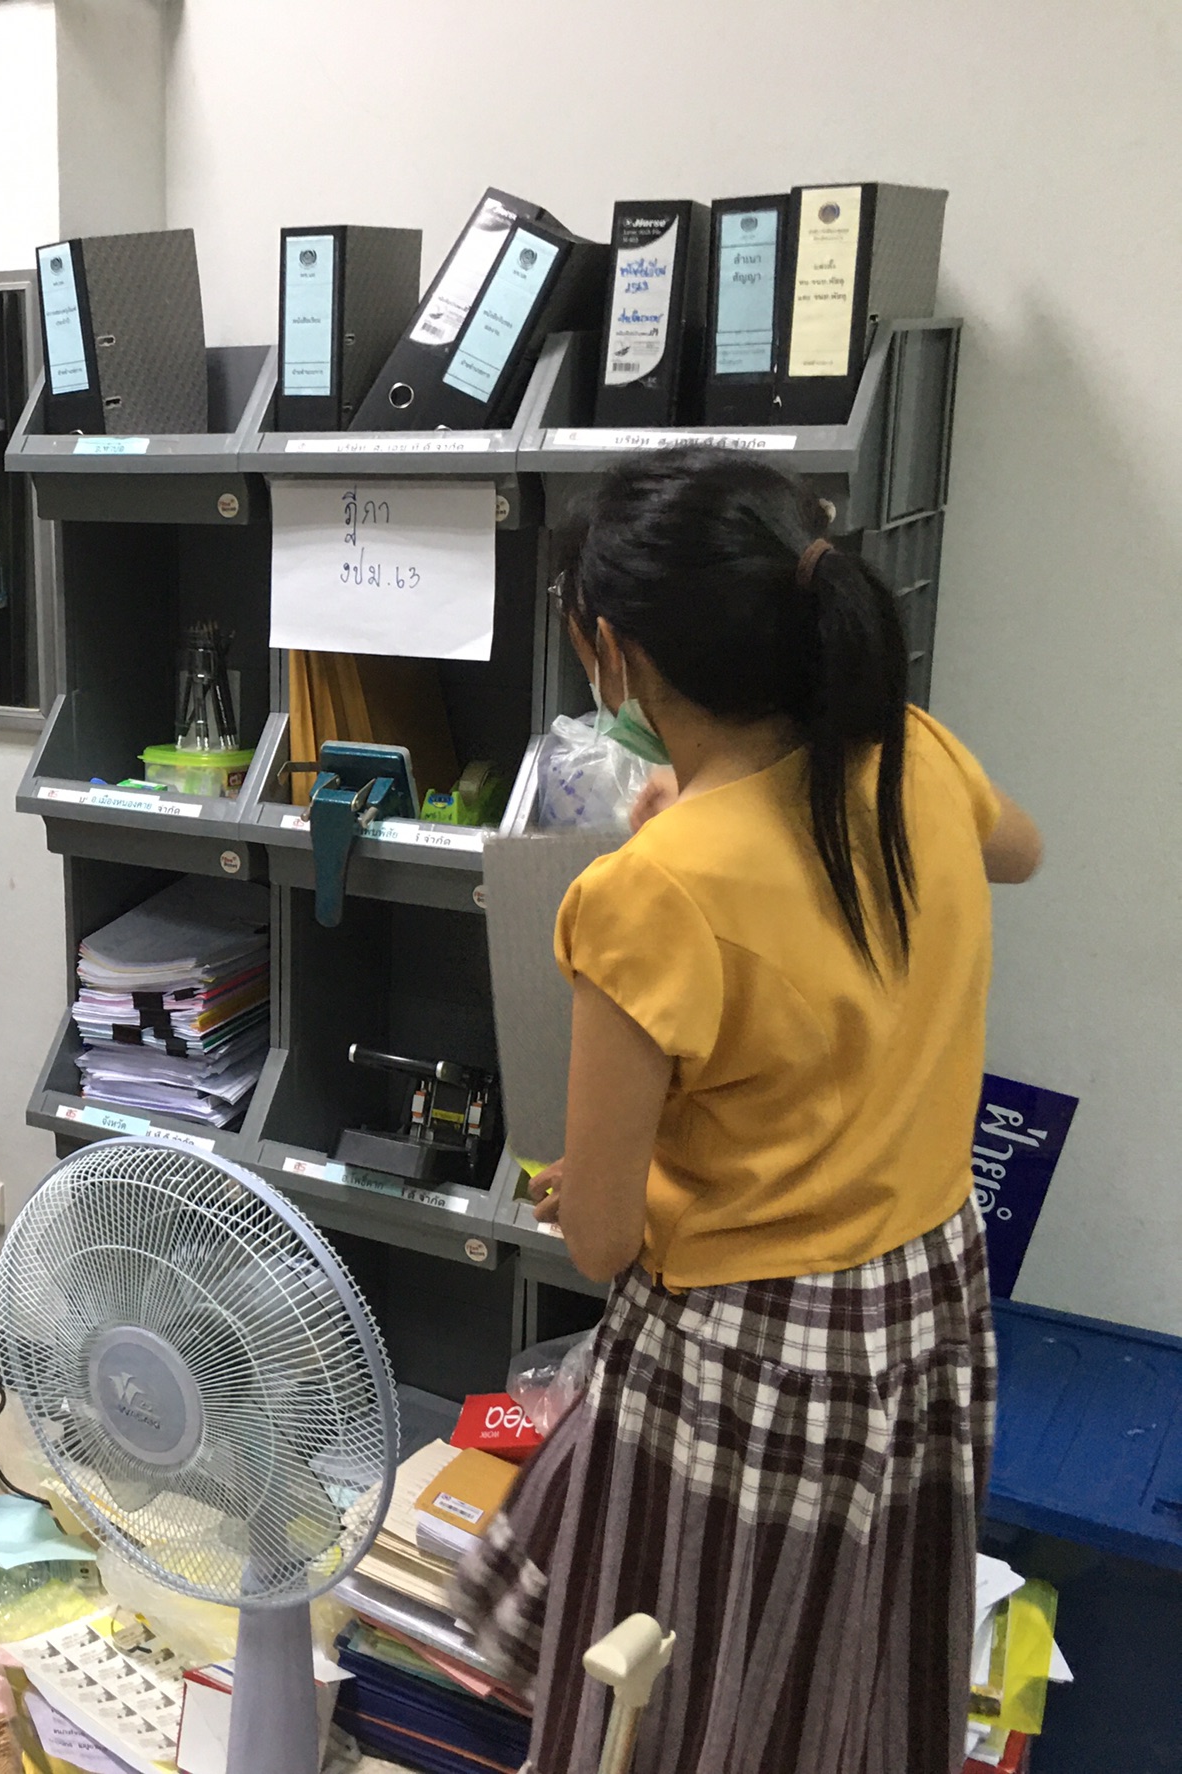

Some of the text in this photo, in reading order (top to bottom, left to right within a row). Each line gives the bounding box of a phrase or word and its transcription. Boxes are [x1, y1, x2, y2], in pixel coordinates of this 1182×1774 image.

[733, 252, 762, 265] สำเนา
[732, 271, 762, 285] สัญญา
[90, 794, 152, 811] อ.เมืองหนองคาย
[157, 803, 181, 815] จำกัด
[423, 833, 452, 846] จำกัด
[101, 1115, 127, 1131] จังหวัด
[341, 1172, 385, 1190] อ.โพธิ์ตาก
[418, 1191, 447, 1208] จำกัด
[484, 1405, 536, 1438] dea
